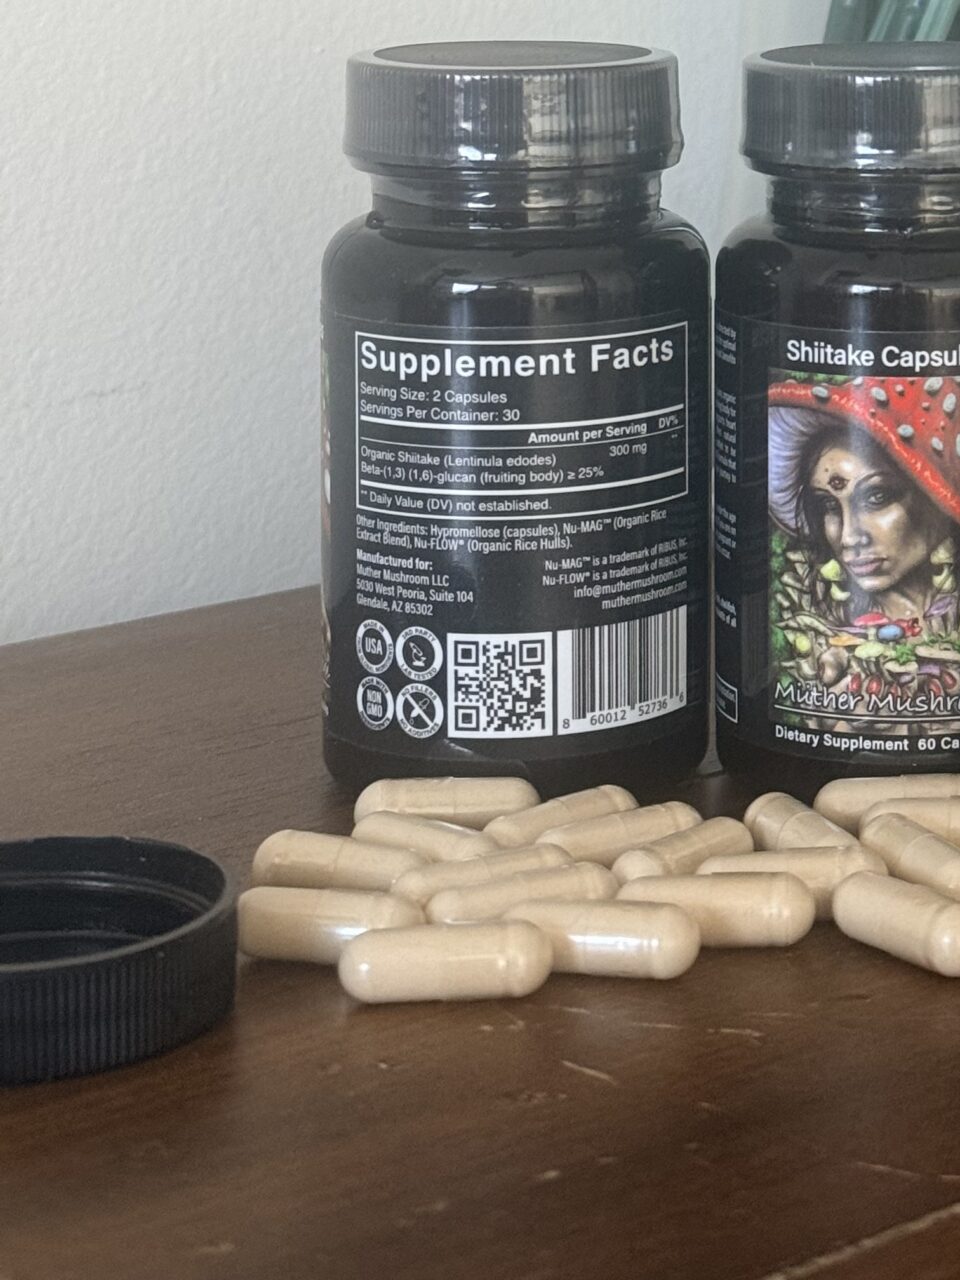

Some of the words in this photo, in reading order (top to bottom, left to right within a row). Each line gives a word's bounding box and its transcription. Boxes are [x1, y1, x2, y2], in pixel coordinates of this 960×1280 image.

[361, 341, 576, 382] Supplement
[591, 338, 674, 372] Facts
[787, 340, 875, 366] Shiitake
[360, 381, 397, 401] Serving
[400, 387, 430, 401] Size:
[432, 390, 442, 402] 2
[445, 390, 507, 405] Capsules
[360, 400, 403, 418] Servings
[406, 406, 427, 419] Per
[431, 407, 499, 421] Container:
[502, 409, 520, 421] 30
[528, 430, 579, 444] Amount
[583, 429, 603, 442] per
[606, 423, 648, 437] Serving
[658, 415, 679, 429] DV%
[360, 445, 395, 461] Organic
[398, 451, 440, 465] Shiitake
[444, 455, 503, 467] (Lentinula
[506, 454, 557, 467] edodes)
[609, 444, 630, 457] 300
[632, 443, 648, 455] mg
[360, 461, 405, 480] Beta-(1,3)
[409, 468, 477, 485] (1,6)-glucan
[480, 471, 526, 485] (fruiting
[530, 469, 564, 484] body)
[578, 466, 604, 479] 25%
[370, 491, 393, 506] Daily
[395, 495, 424, 508] Value
[427, 498, 452, 512] (DV)
[456, 498, 475, 511] not
[479, 499, 552, 512] established.
[356, 514, 375, 528] Other
[377, 518, 428, 536] Ingredients:
[430, 524, 500, 540] Hypromellose
[503, 523, 561, 539] (capsules),
[613, 512, 650, 531] (Organic
[651, 509, 667, 521] Rice
[356, 527, 381, 541] Extract
[467, 539, 512, 554] (Organic
[515, 539, 538, 551] Rice
[540, 536, 573, 550] Hulls).
[356, 548, 413, 569] Manufactured
[416, 558, 433, 571] for:
[592, 555, 600, 566] is
[602, 556, 607, 564] a
[609, 547, 650, 563] trademark
[651, 544, 658, 555] of
[356, 563, 381, 578] Muther
[383, 567, 430, 586] Mushroom
[432, 574, 450, 587] LLC
[592, 570, 600, 581] is
[602, 570, 607, 580] a
[609, 562, 650, 579] trademark
[651, 559, 658, 570] of
[356, 577, 374, 590] 5030
[375, 581, 396, 597] West
[396, 585, 427, 601] Peoria,
[429, 589, 454, 602] Suite
[456, 591, 474, 603] 104
[574, 566, 688, 599] info@muthermushroom.com
[356, 593, 390, 612] Glendale,
[391, 600, 403, 613] AZ
[405, 602, 433, 616] 85302
[365, 636, 383, 656] USA
[562, 718, 570, 729] 8
[590, 710, 627, 726] 60012
[638, 699, 668, 716] 52736
[775, 725, 819, 747] Dietary
[823, 734, 909, 752] Supplement
[918, 737, 936, 751] 60
